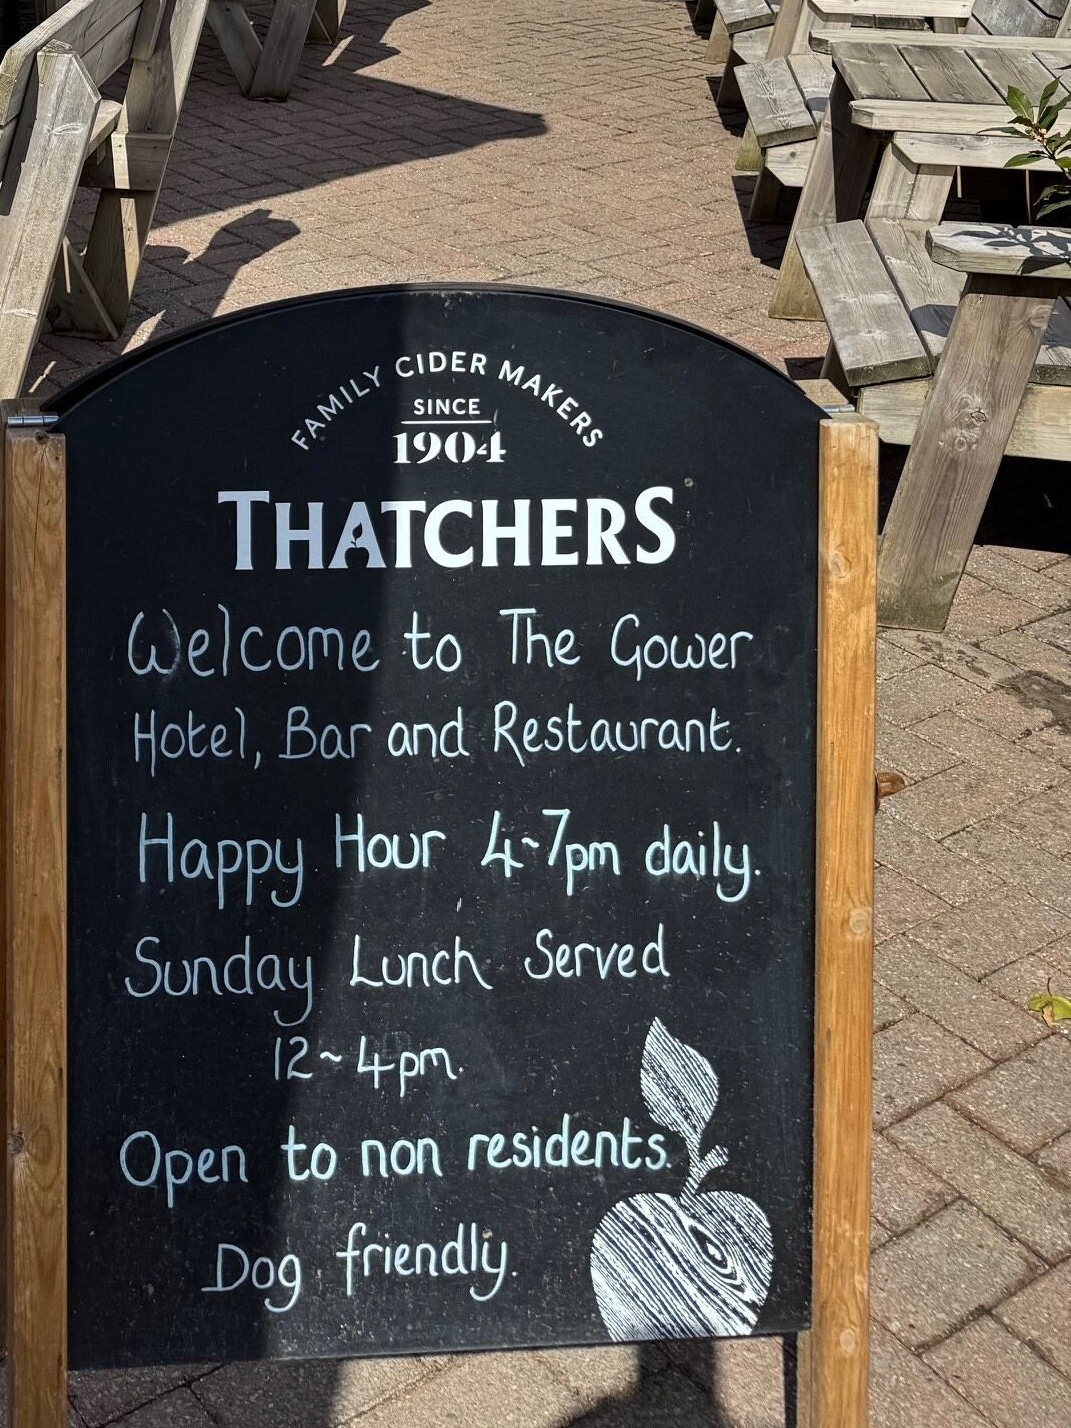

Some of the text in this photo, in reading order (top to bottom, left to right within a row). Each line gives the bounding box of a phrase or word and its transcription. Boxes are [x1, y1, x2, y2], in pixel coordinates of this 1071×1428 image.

[291, 351, 604, 451] FAMILY CIDER MAKERS
[413, 398, 481, 415] SINCE
[392, 431, 506, 464] 1904
[128, 604, 753, 680] Welcome to The Gower
[133, 700, 742, 777] Hotel, Bar and Restaurant.
[138, 812, 303, 909] Happy
[335, 812, 446, 870] Hour
[124, 922, 670, 1027] Sunday Lunch Served
[119, 1130, 248, 1208] Open
[281, 1124, 337, 1181] to
[361, 1138, 441, 1177] non
[201, 1243, 301, 1313] Dog
